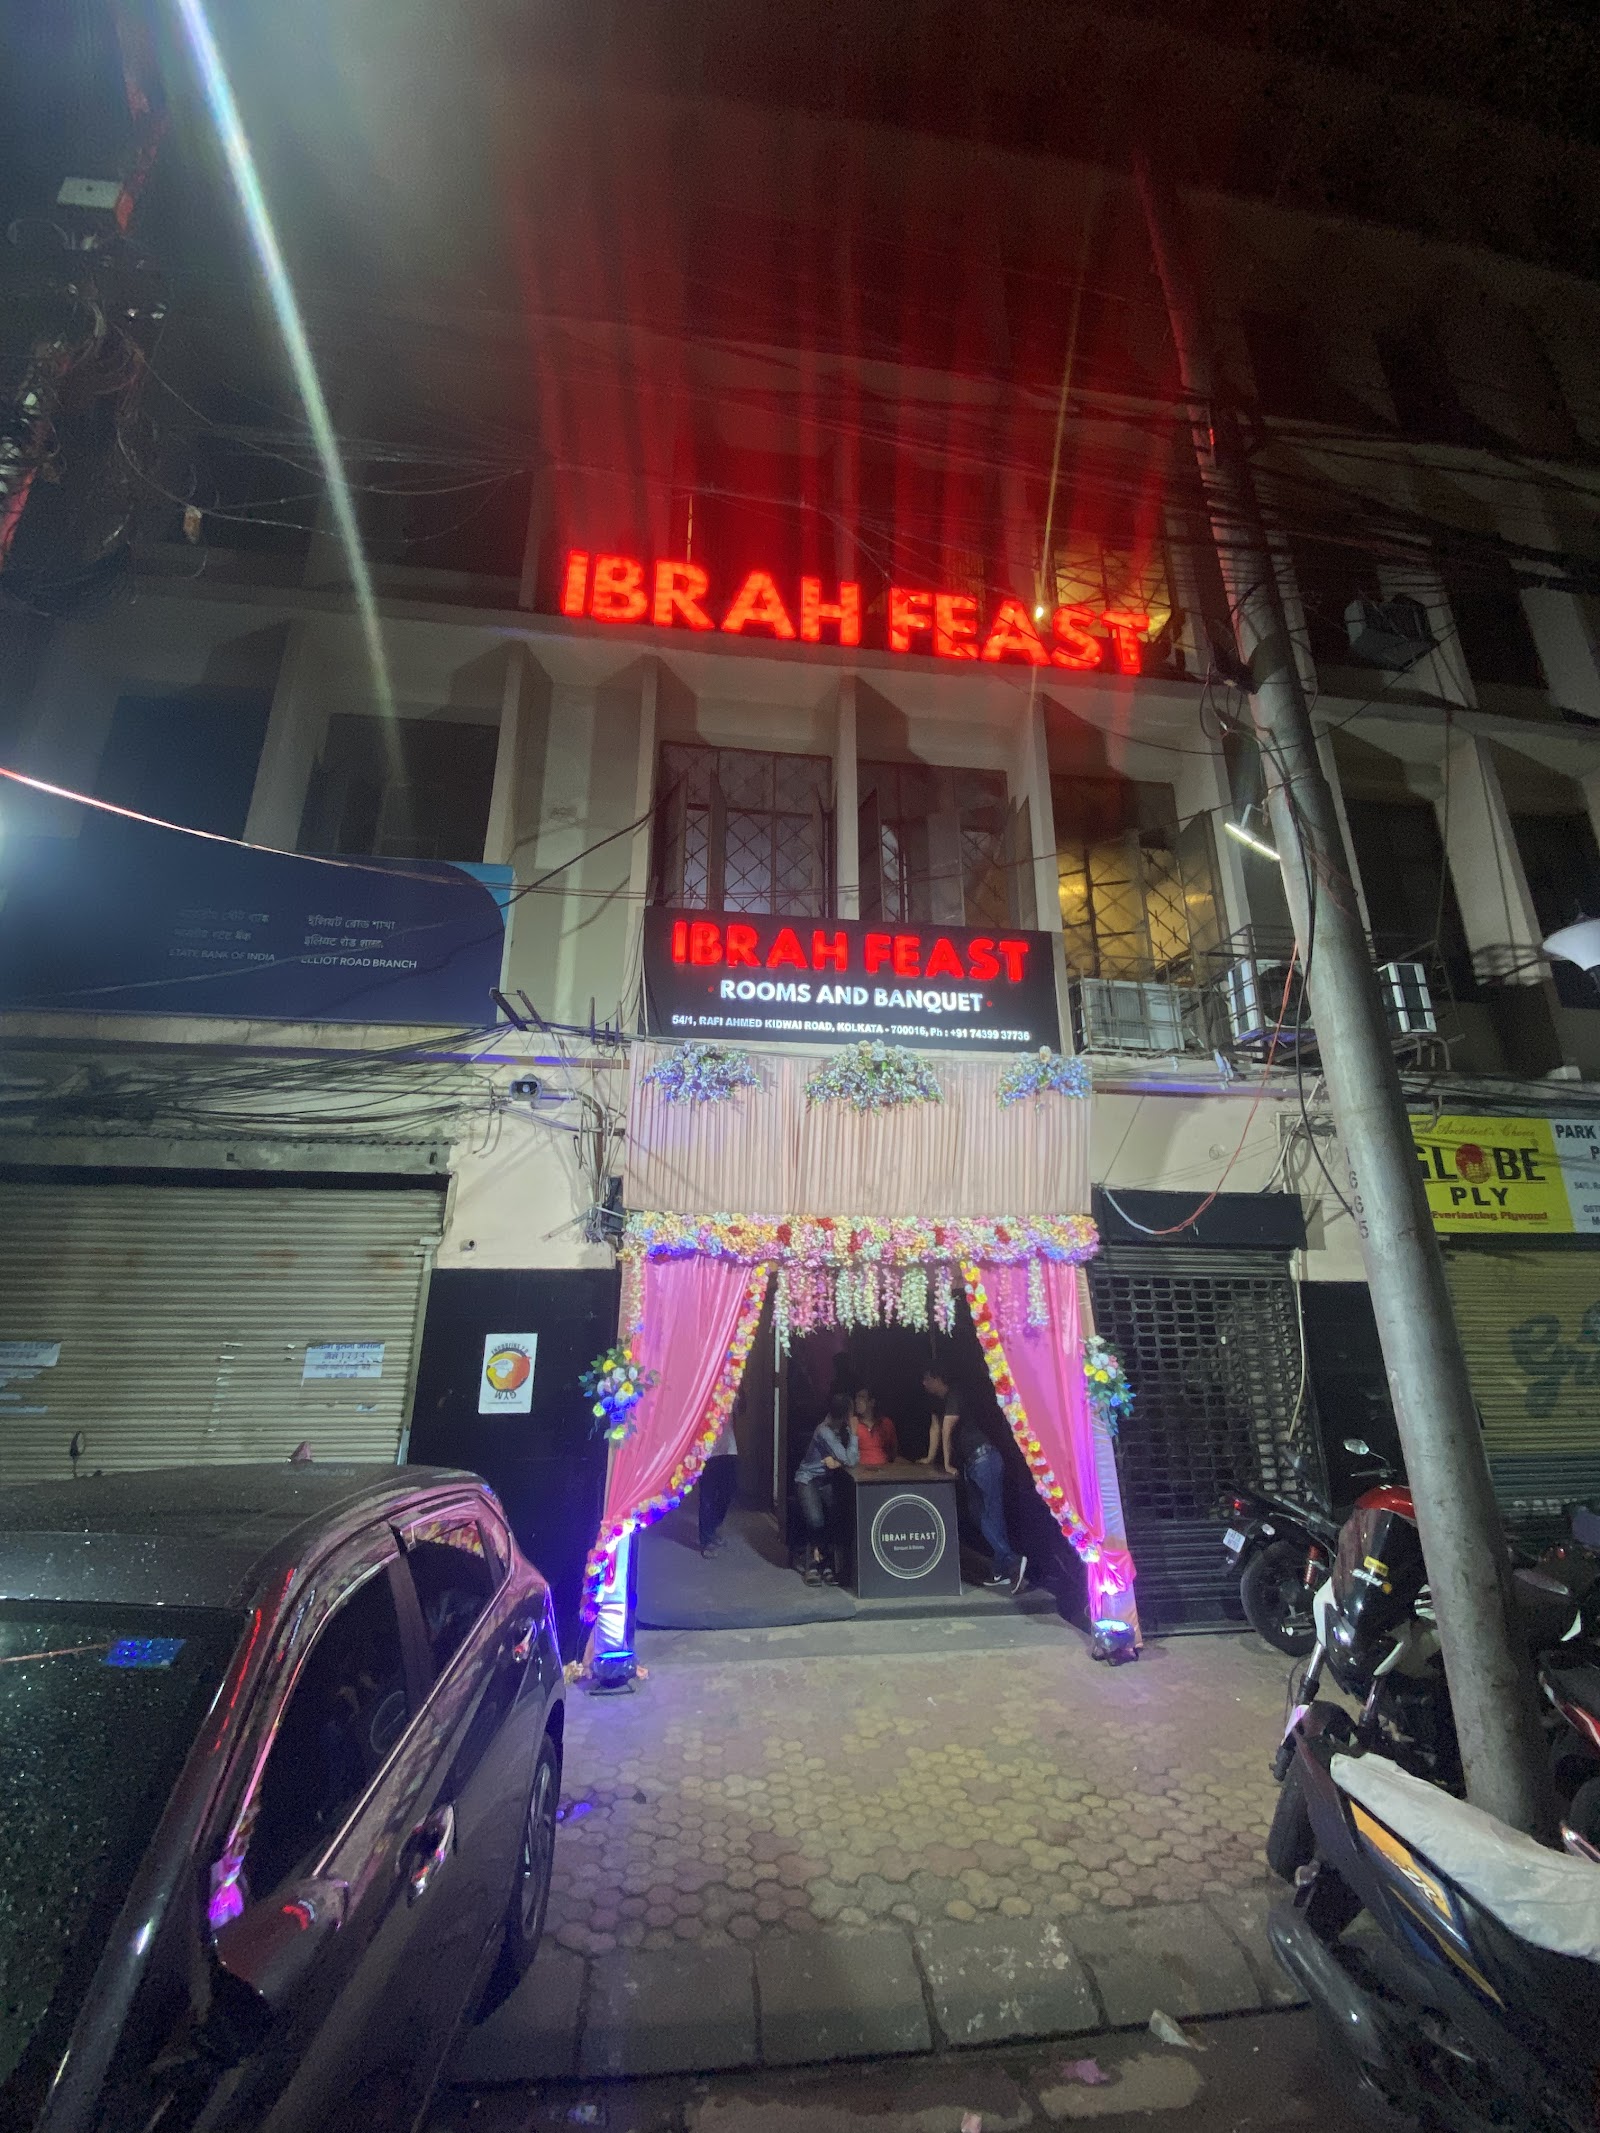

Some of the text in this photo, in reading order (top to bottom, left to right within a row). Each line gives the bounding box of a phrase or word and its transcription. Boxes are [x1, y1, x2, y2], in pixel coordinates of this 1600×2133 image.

[562, 549, 1150, 674] IBRAH FEAST
[202, 950, 229, 959] BANK
[231, 951, 245, 960] OF
[247, 952, 275, 961] INDIA
[671, 920, 1030, 983] IBRAH FEAST
[340, 957, 370, 967] ROAD
[372, 959, 417, 968] BRANCH
[720, 979, 983, 1014] ROOMS AND BANQUET
[672, 1015, 697, 1026] 54/1,
[699, 1016, 723, 1026] RAFI
[725, 1017, 763, 1028] AHMED
[764, 1019, 802, 1030] KIDWAI
[804, 1021, 835, 1032] ROAD,
[837, 1022, 884, 1034] KOLKATA
[891, 1025, 929, 1037] 700016,
[950, 1028, 967, 1039] +91
[970, 1029, 999, 1040] 74399
[1555, 1124, 1597, 1139] PARK
[1450, 1186, 1508, 1206] PLY
[1431, 1210, 1547, 1221] Everlasting Plywood
[881, 1532, 936, 1541] IBRAH FEAST
